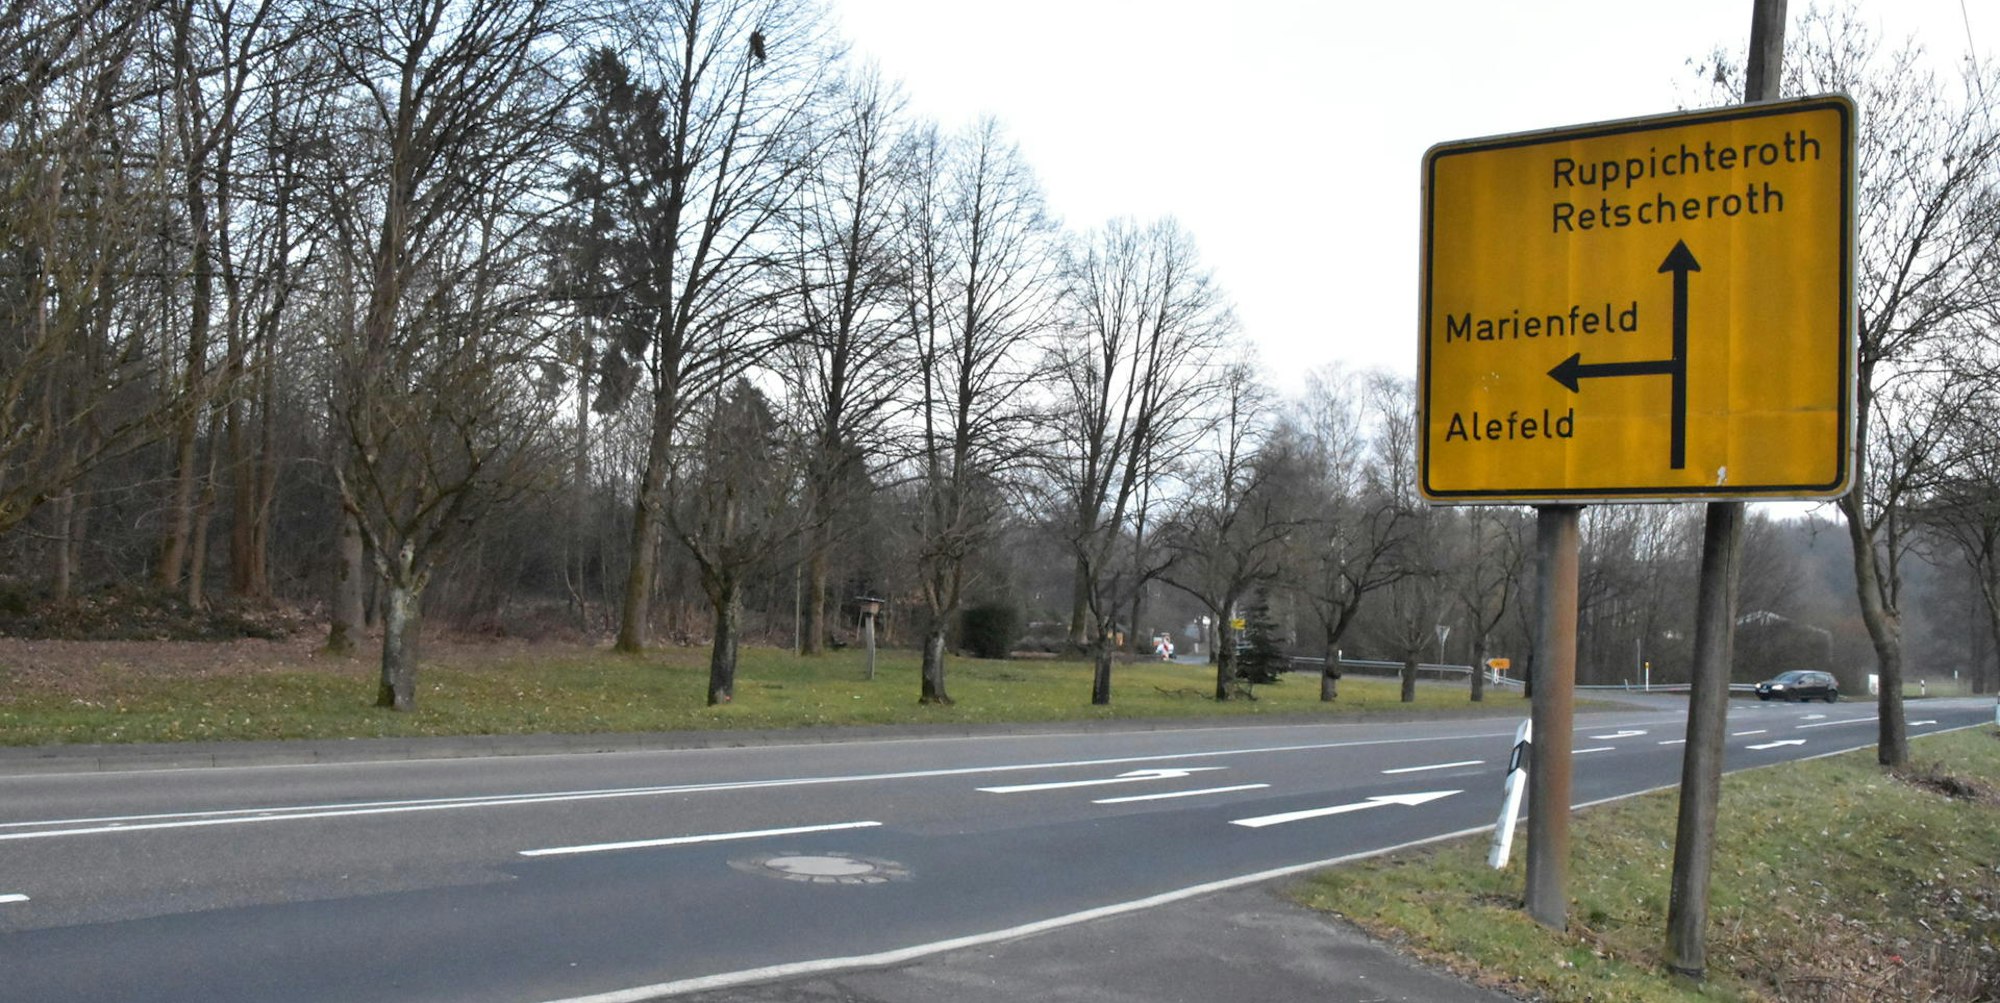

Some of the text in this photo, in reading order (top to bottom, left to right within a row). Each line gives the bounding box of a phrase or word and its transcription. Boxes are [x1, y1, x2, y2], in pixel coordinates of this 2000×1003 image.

[1553, 129, 1821, 191] Ruppichteroth
[1552, 182, 1784, 233] Retscheroth
[1446, 301, 1638, 343] Marienfeld
[1445, 408, 1575, 442] Alefeld
